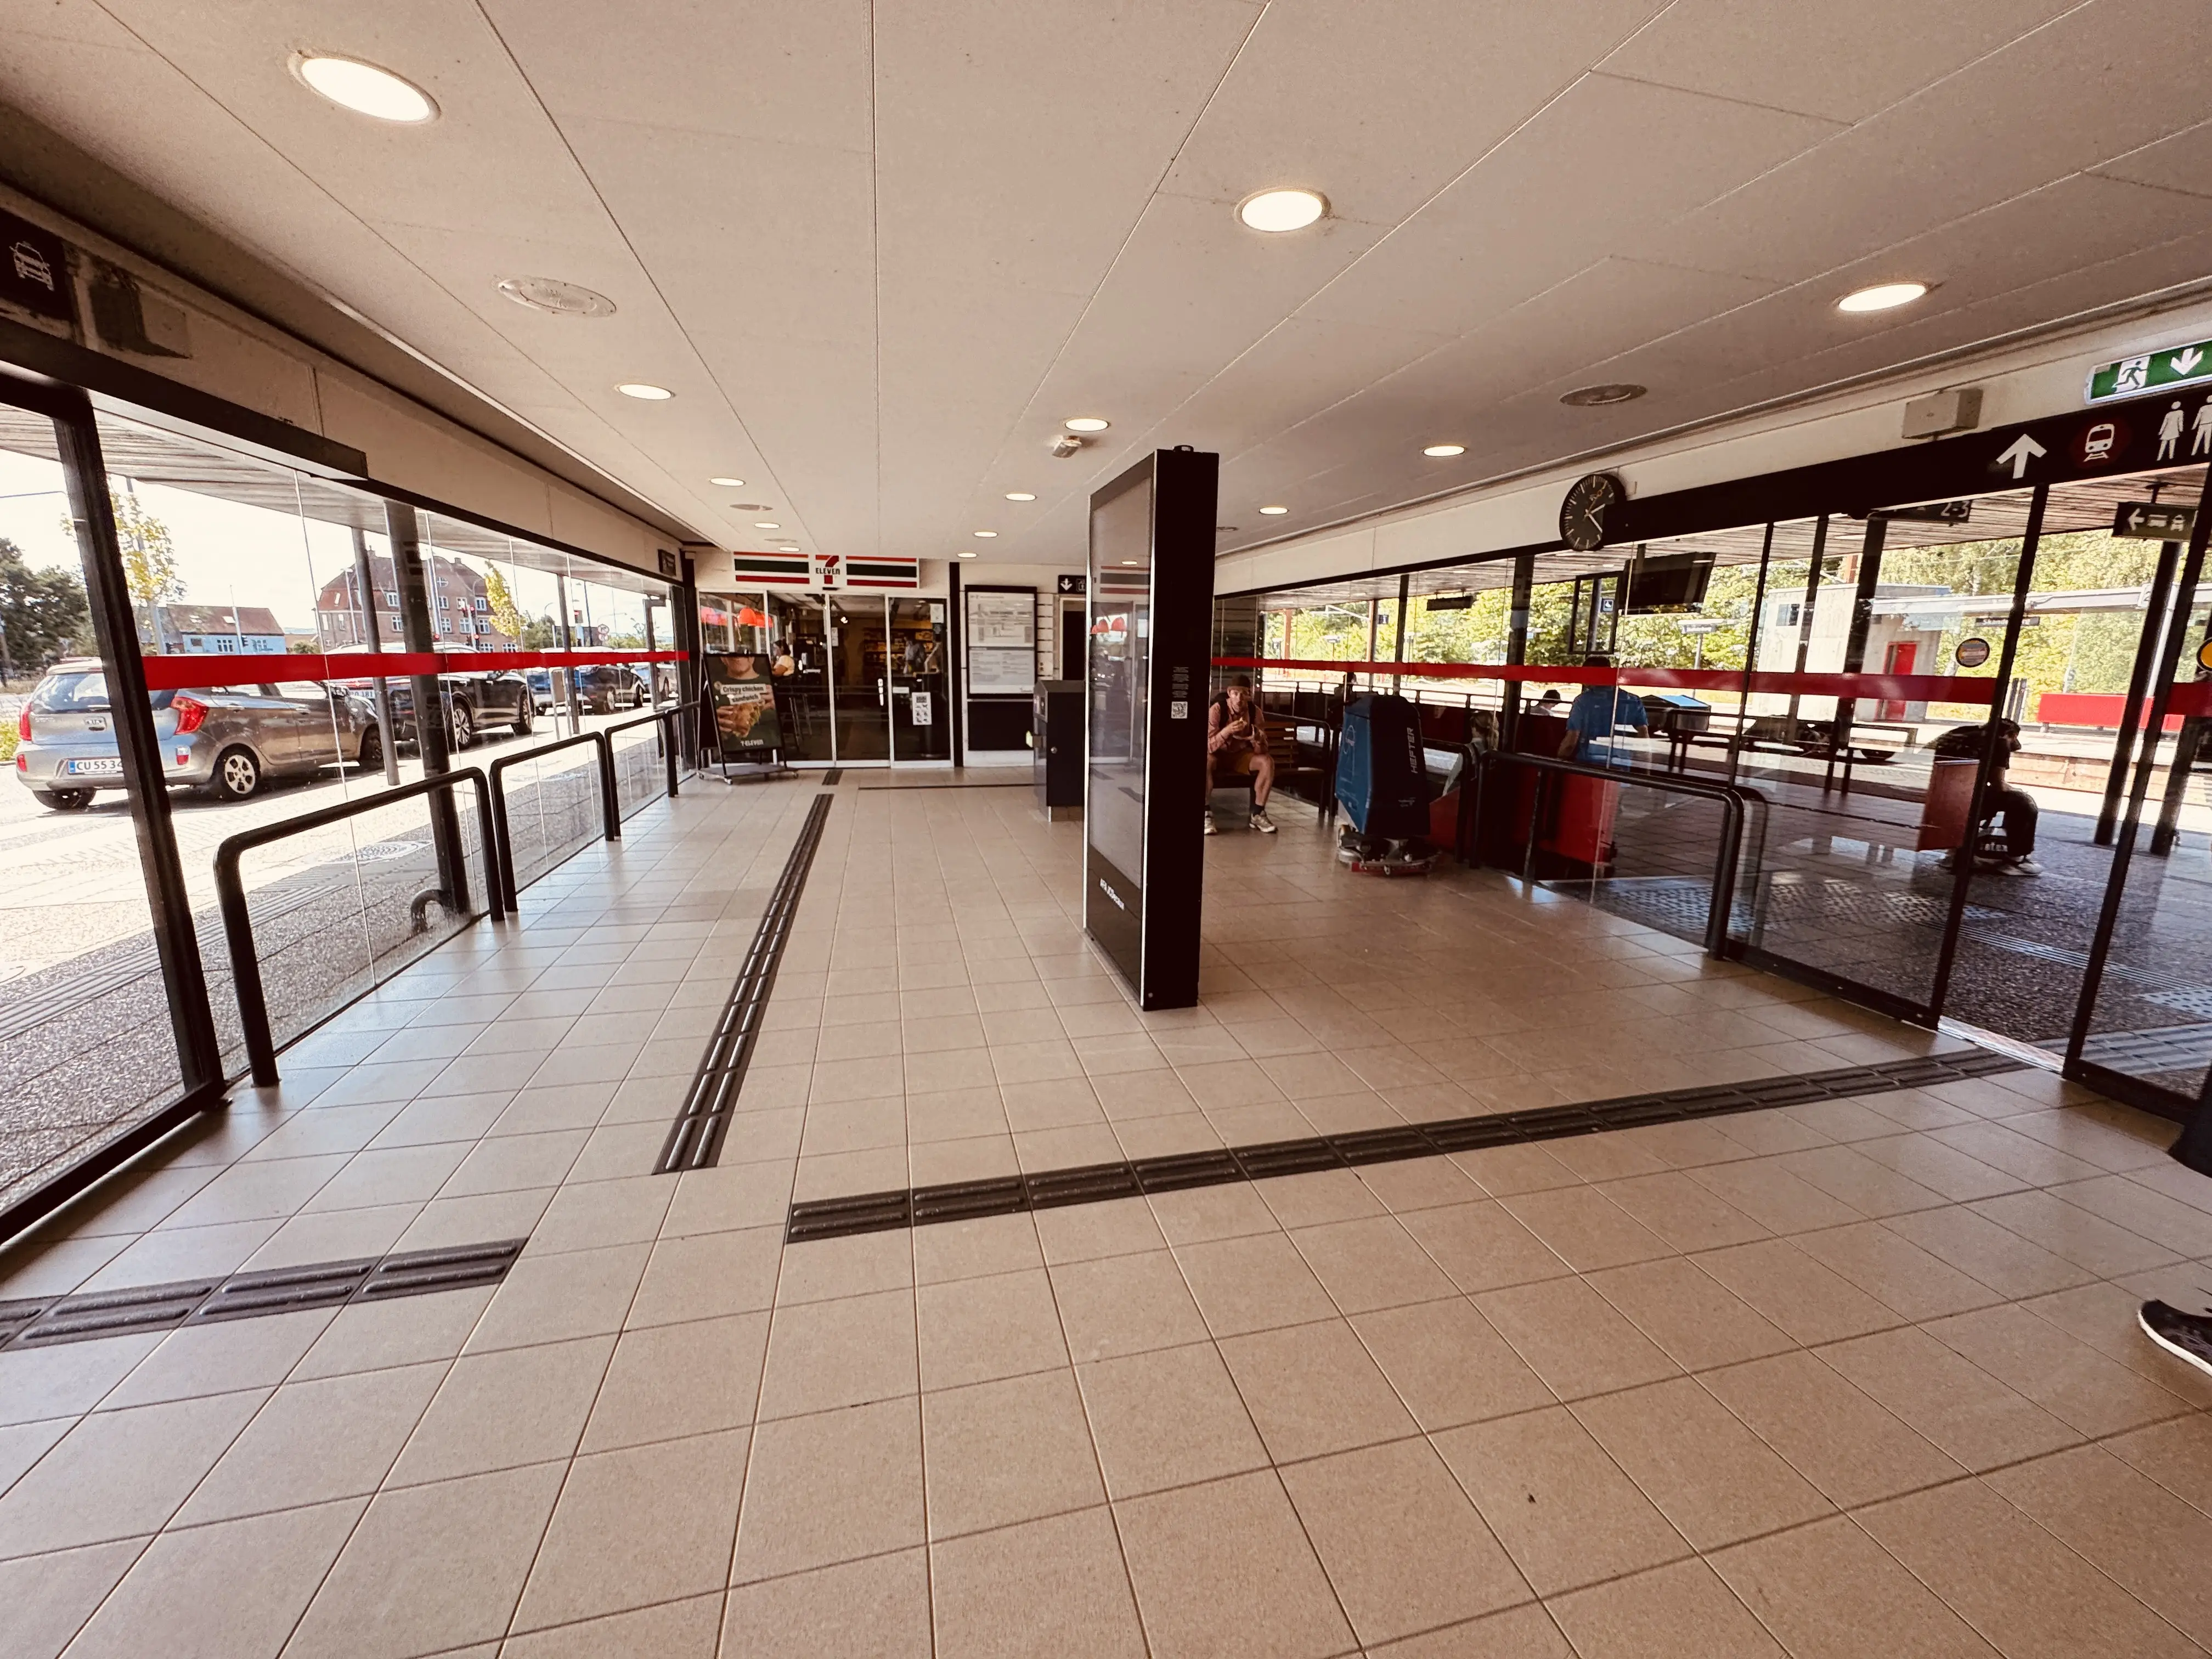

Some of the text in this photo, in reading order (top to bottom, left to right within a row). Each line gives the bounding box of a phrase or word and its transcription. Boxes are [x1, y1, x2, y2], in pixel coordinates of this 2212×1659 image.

[815, 555, 839, 584] 7
[1406, 727, 1419, 774] HEFTER
[76, 761, 91, 771] CU
[94, 760, 108, 770] 55
